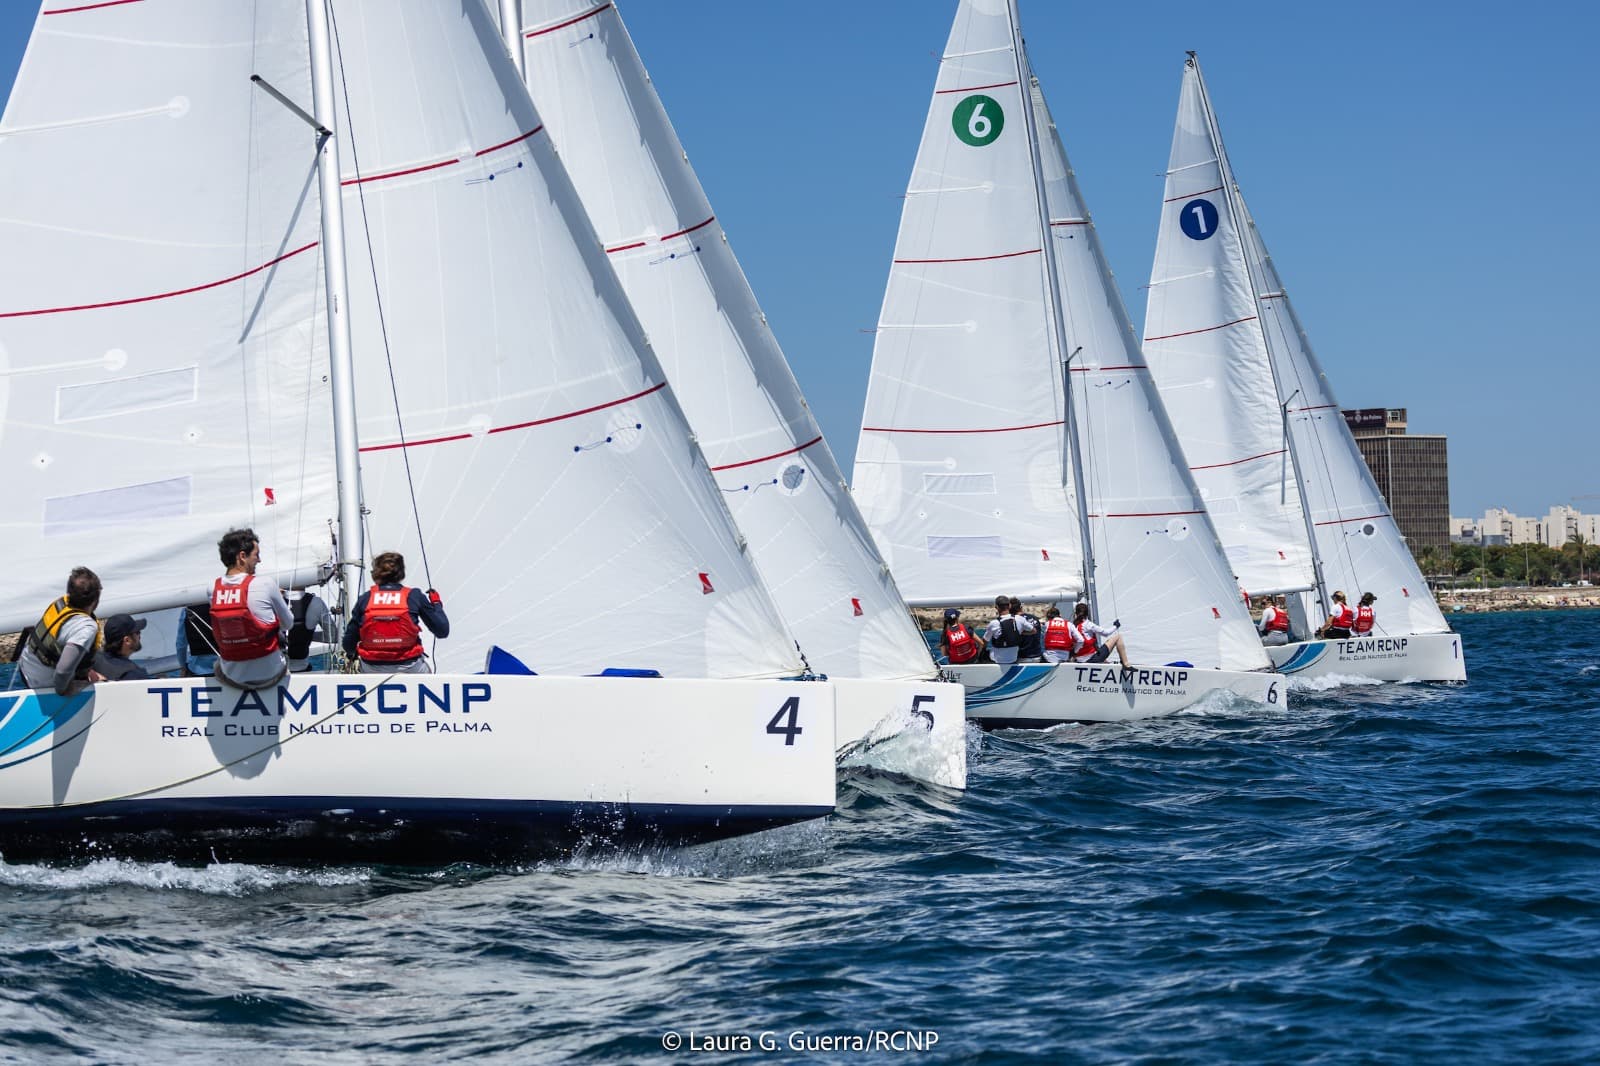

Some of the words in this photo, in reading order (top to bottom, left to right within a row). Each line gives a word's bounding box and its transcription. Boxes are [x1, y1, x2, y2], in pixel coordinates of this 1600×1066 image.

[968, 103, 992, 138] 6
[1191, 206, 1208, 234] 1
[216, 589, 241, 605] HH
[373, 592, 401, 605] HH
[1051, 620, 1065, 628] HH
[950, 630, 966, 642] HH
[1337, 640, 1375, 654] TEAM
[1377, 638, 1408, 652] RCNP
[1452, 639, 1458, 660] 1
[1074, 667, 1135, 684] TEAM
[1138, 670, 1188, 686] RCNP
[147, 684, 318, 718] TEAM
[336, 683, 492, 715] RCNP
[1268, 681, 1278, 704] 6
[766, 696, 803, 746] 4
[911, 695, 936, 732] 5
